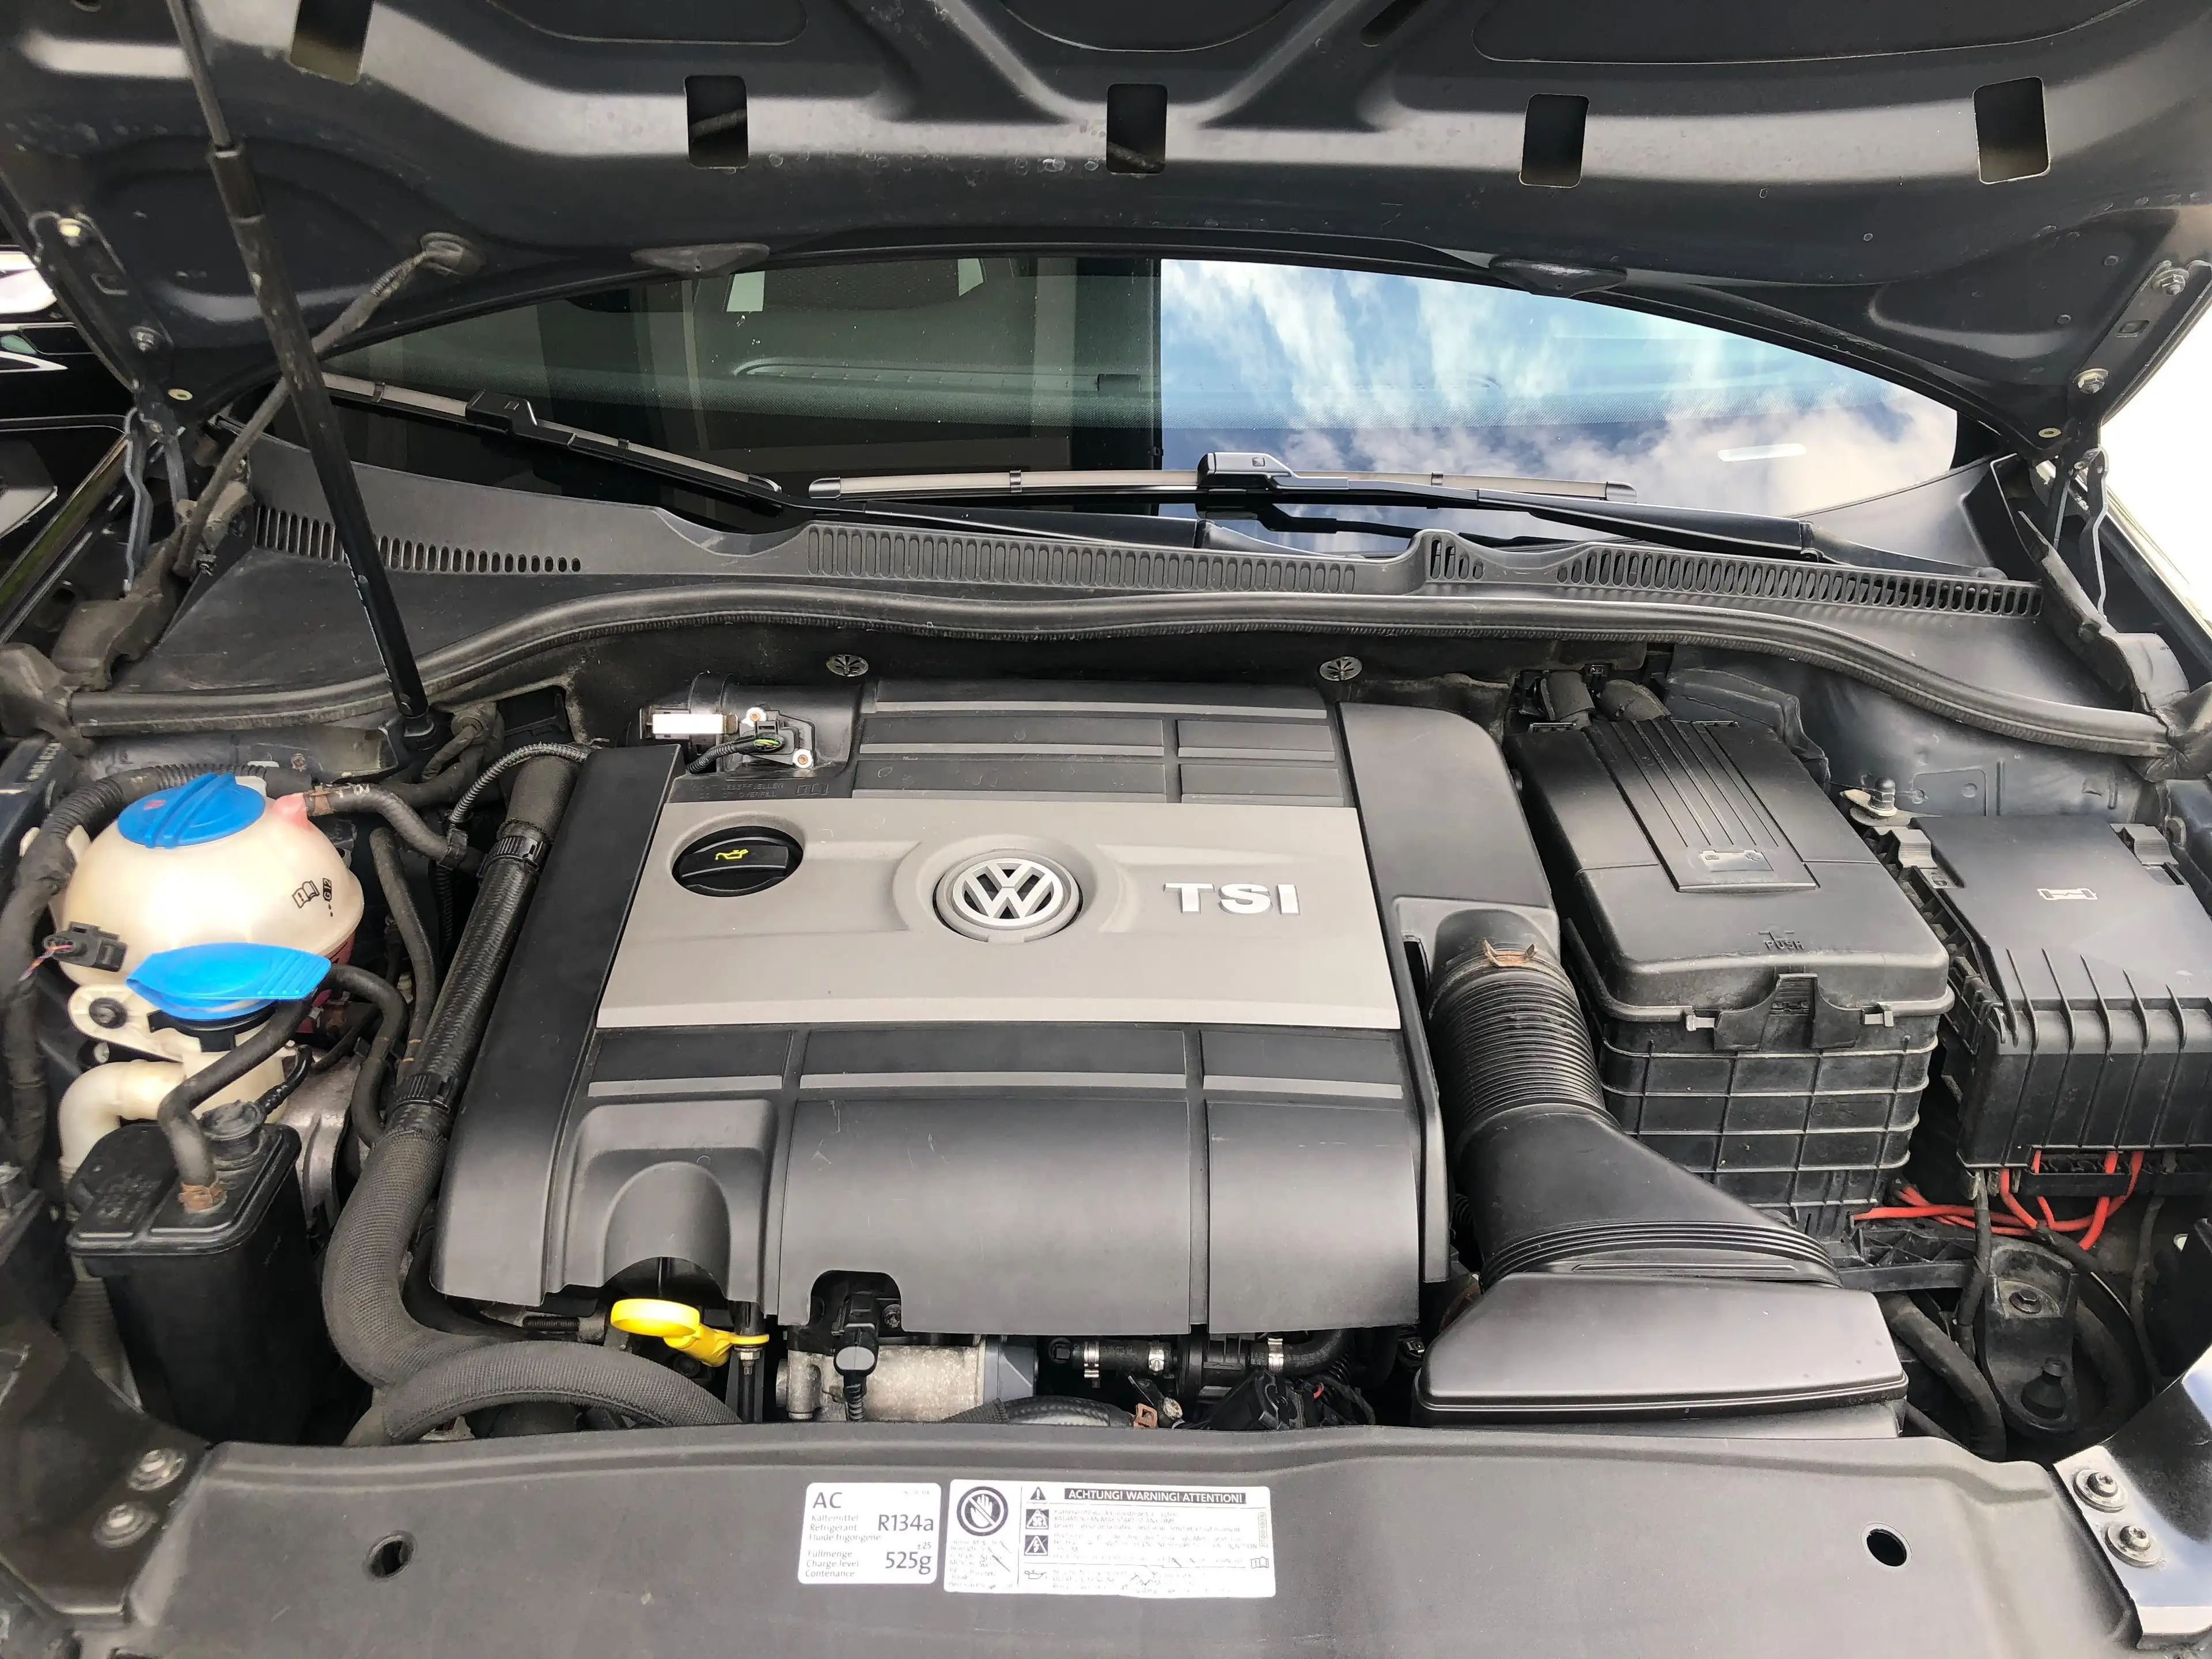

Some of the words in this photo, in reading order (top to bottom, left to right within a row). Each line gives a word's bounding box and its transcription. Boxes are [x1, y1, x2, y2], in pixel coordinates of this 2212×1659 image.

[323, 878, 332, 900] G12
[1164, 882, 1301, 916] TSI
[1763, 940, 1804, 952] PUSH
[812, 1492, 842, 1509] AC
[1069, 1489, 1123, 1500] ACHTUNG!
[1127, 1491, 1180, 1502] WARNING!
[1183, 1493, 1243, 1503] ATTENTION!
[878, 1514, 934, 1531] R134a
[916, 1541, 932, 1550] ±25
[806, 1560, 836, 1569] Charge
[885, 1551, 932, 1575] 525g
